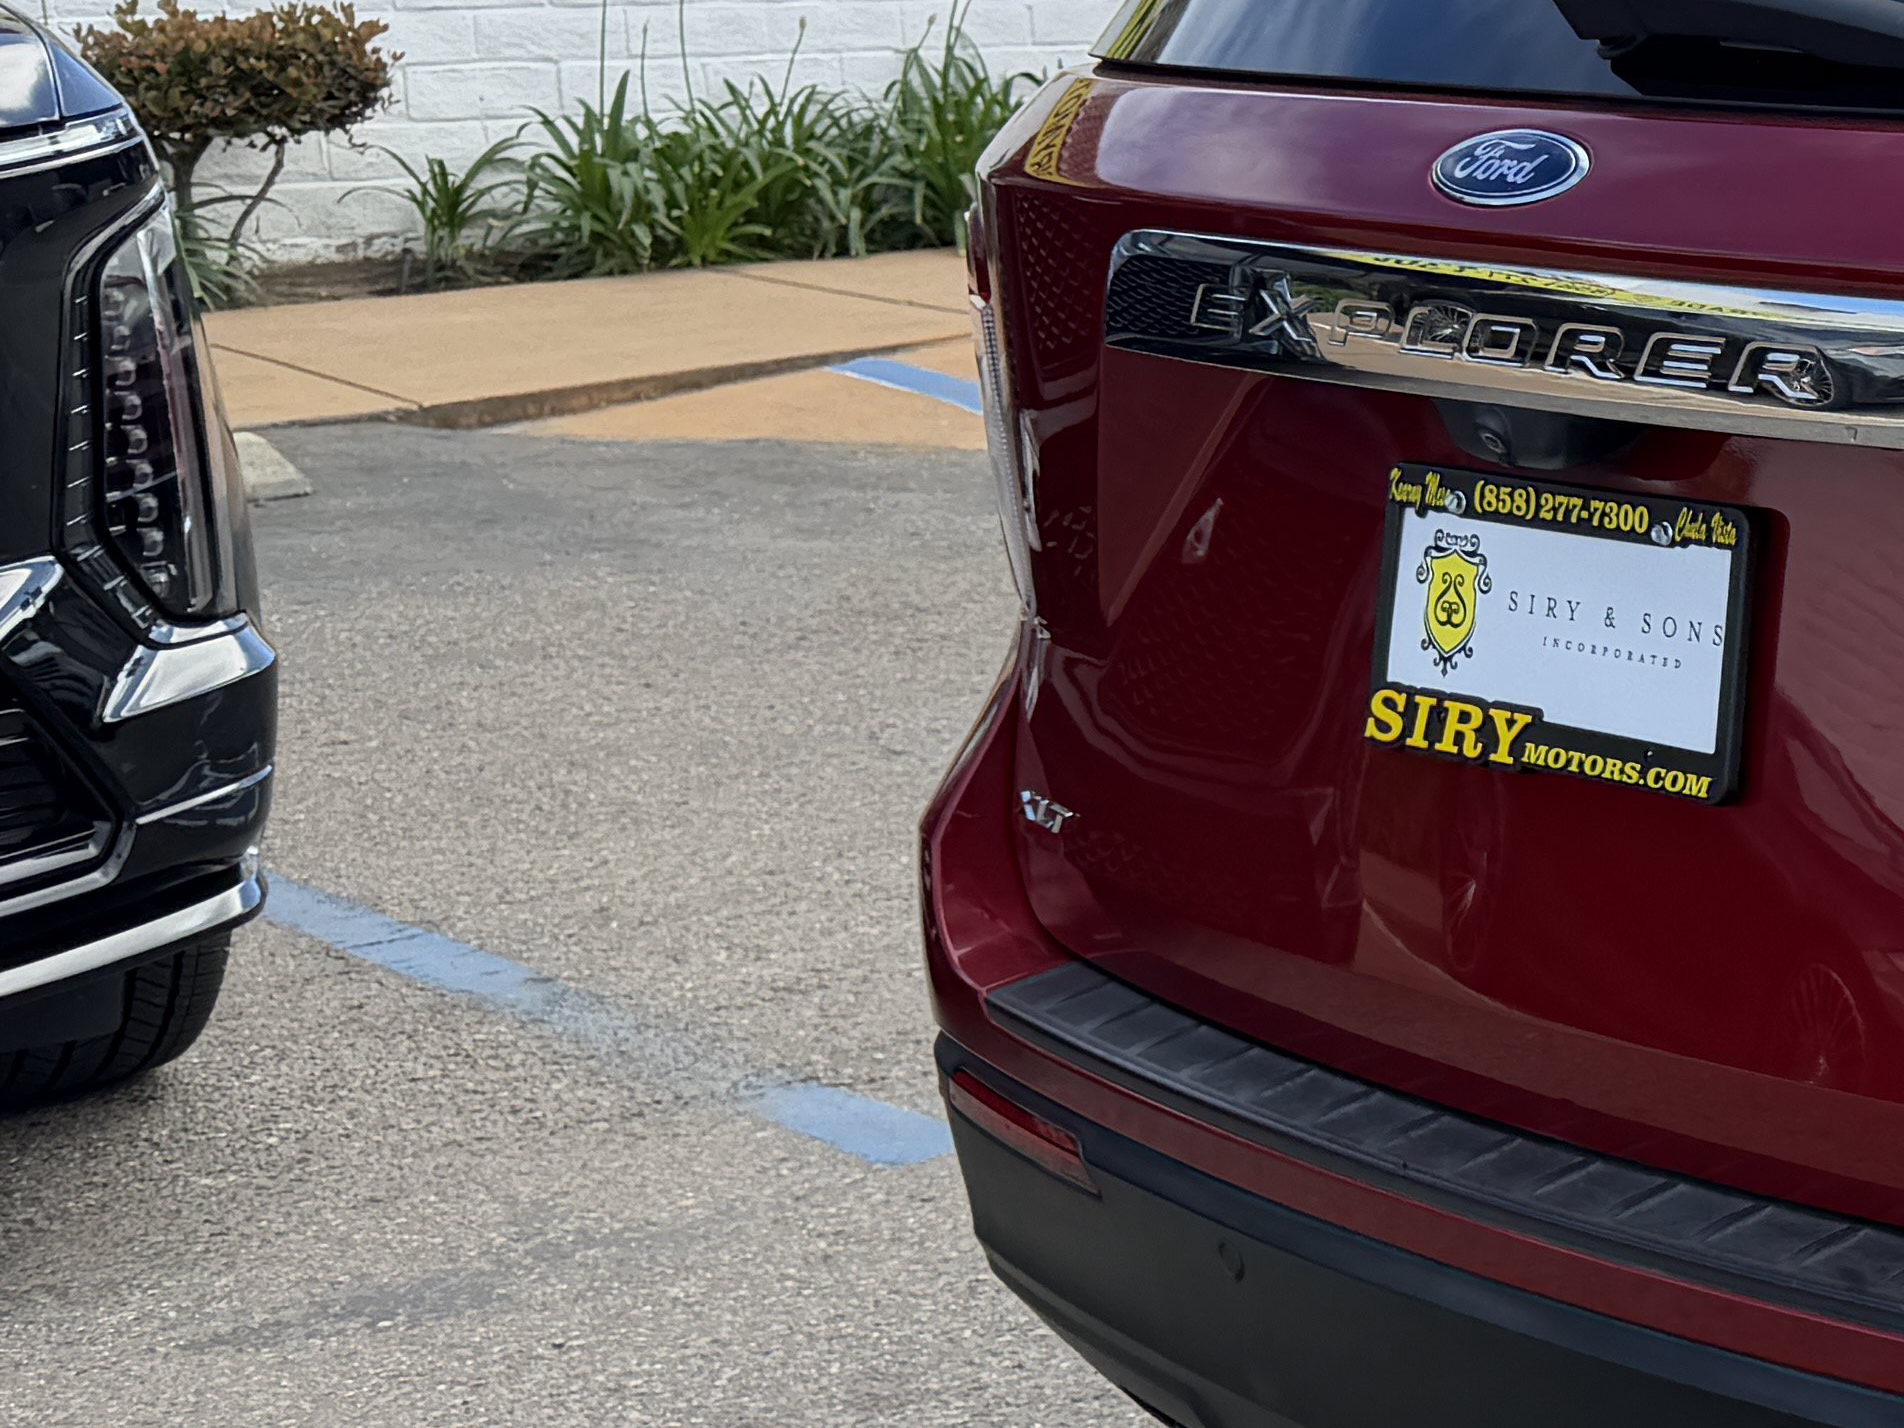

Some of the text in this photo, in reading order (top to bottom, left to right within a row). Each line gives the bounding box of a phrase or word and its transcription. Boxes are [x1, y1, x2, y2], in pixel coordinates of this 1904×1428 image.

[1454, 139, 1549, 184] Ford
[1189, 271, 1819, 402] EXPLORER
[1474, 480, 1536, 520] (858)
[1539, 492, 1649, 534] 277-7300
[1508, 591, 1723, 647] SIRY & SONS
[1542, 635, 1682, 670] INCORPORATED
[1364, 688, 1713, 800] SIRY MOTORS.COM
